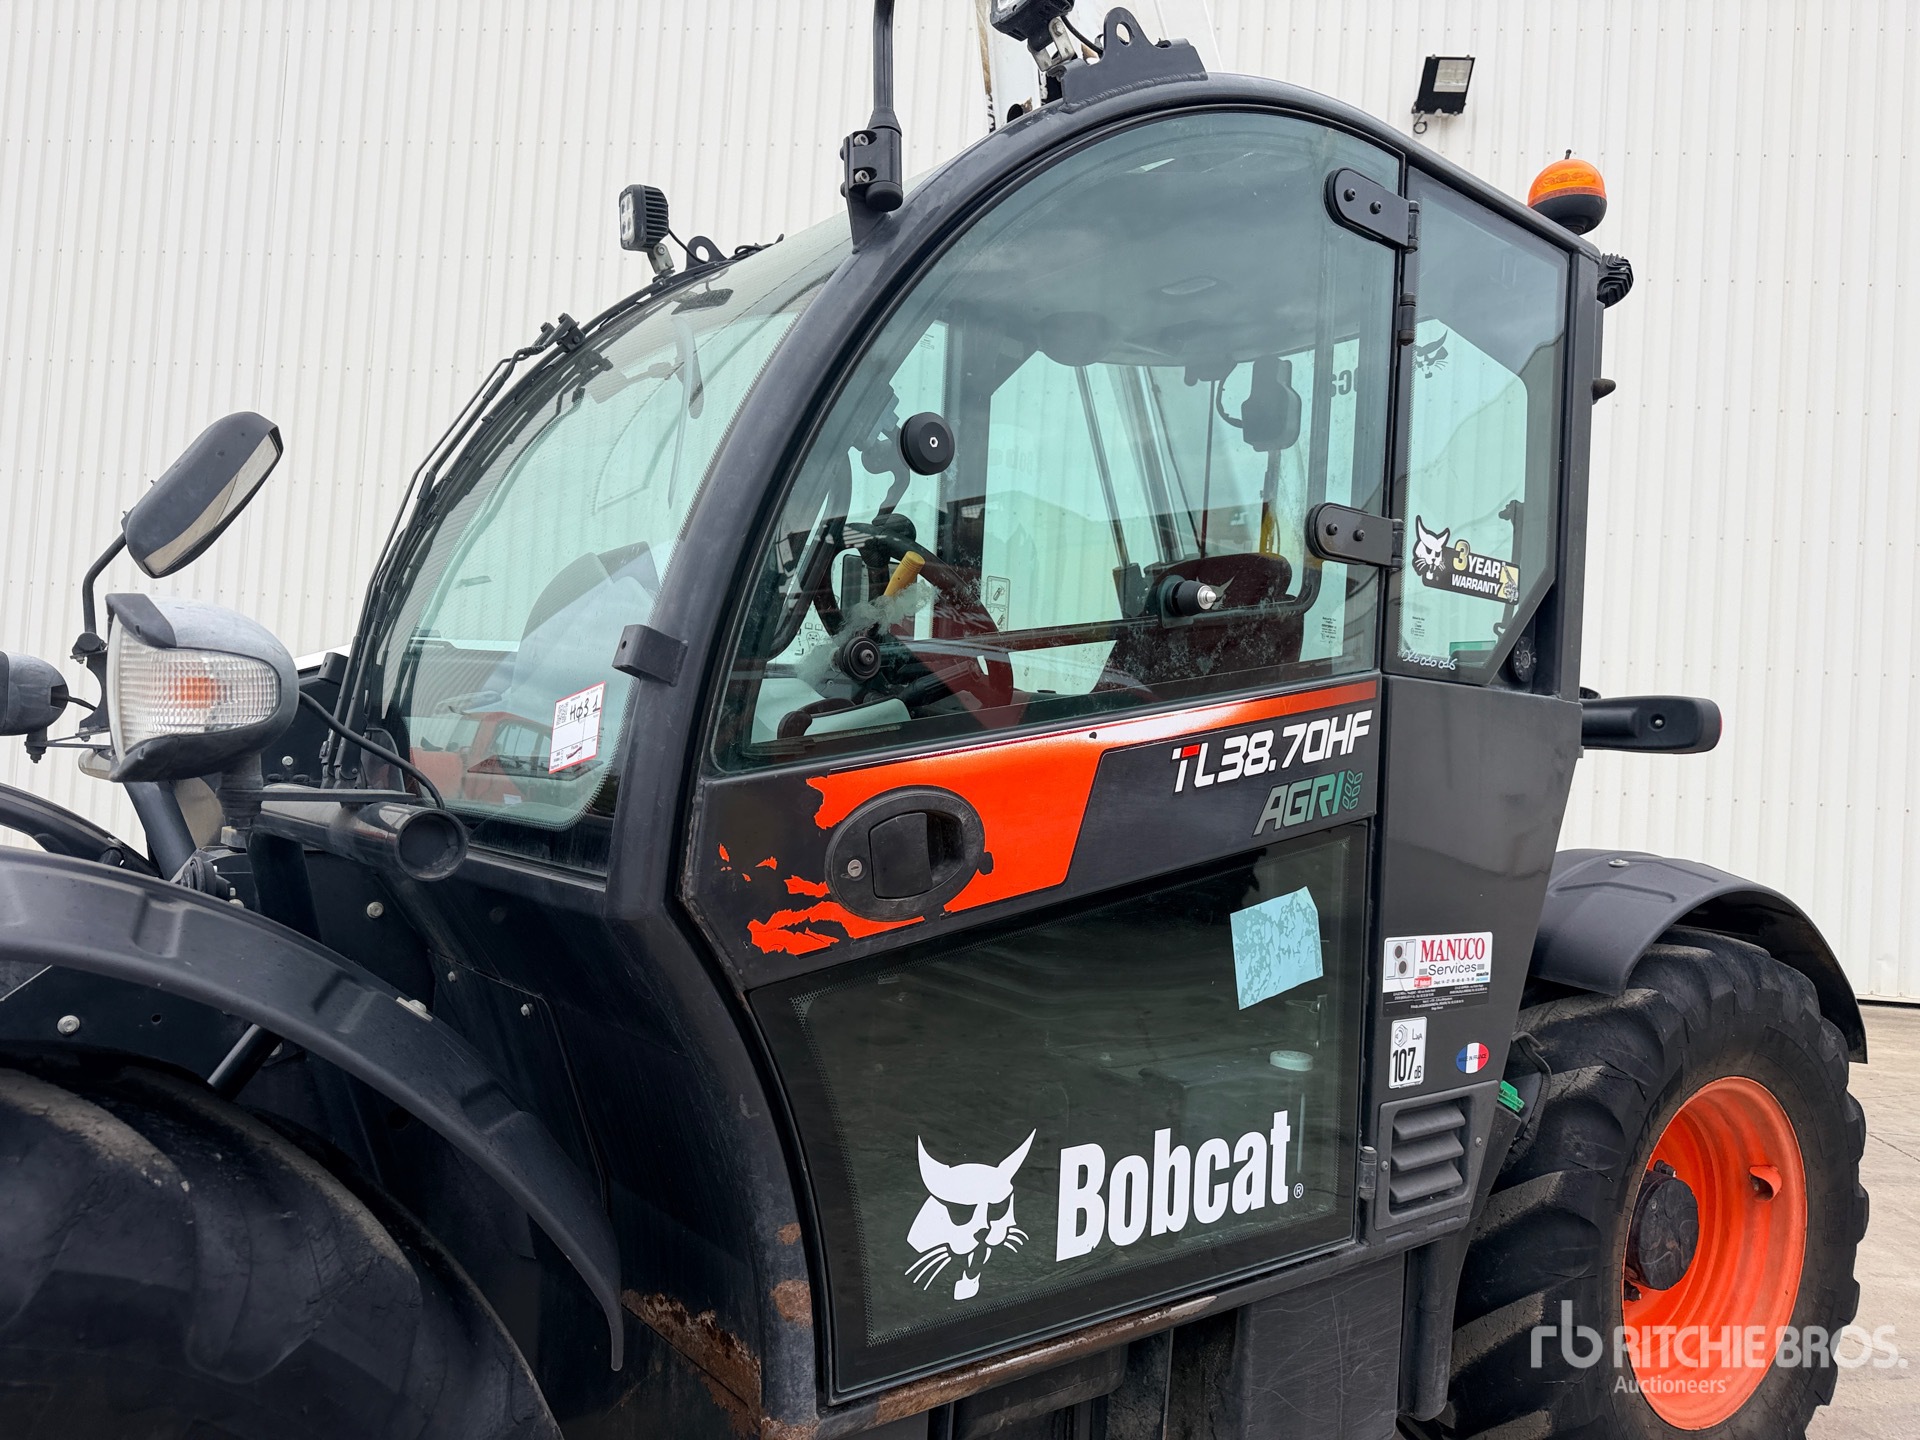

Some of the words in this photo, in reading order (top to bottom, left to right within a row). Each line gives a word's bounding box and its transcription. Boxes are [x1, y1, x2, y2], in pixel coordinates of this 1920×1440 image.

[1453, 540, 1470, 571] 3
[1468, 555, 1501, 579] YEAR
[1451, 573, 1501, 595] WARRANTY
[1171, 709, 1373, 793] TL38.70HF
[1252, 770, 1346, 836] AGRI
[1420, 937, 1486, 963] MANUCO
[1428, 962, 1477, 976] Services
[1392, 1046, 1417, 1083] 107
[1413, 1065, 1422, 1080] dB
[1055, 1110, 1291, 1263] Bobcat
